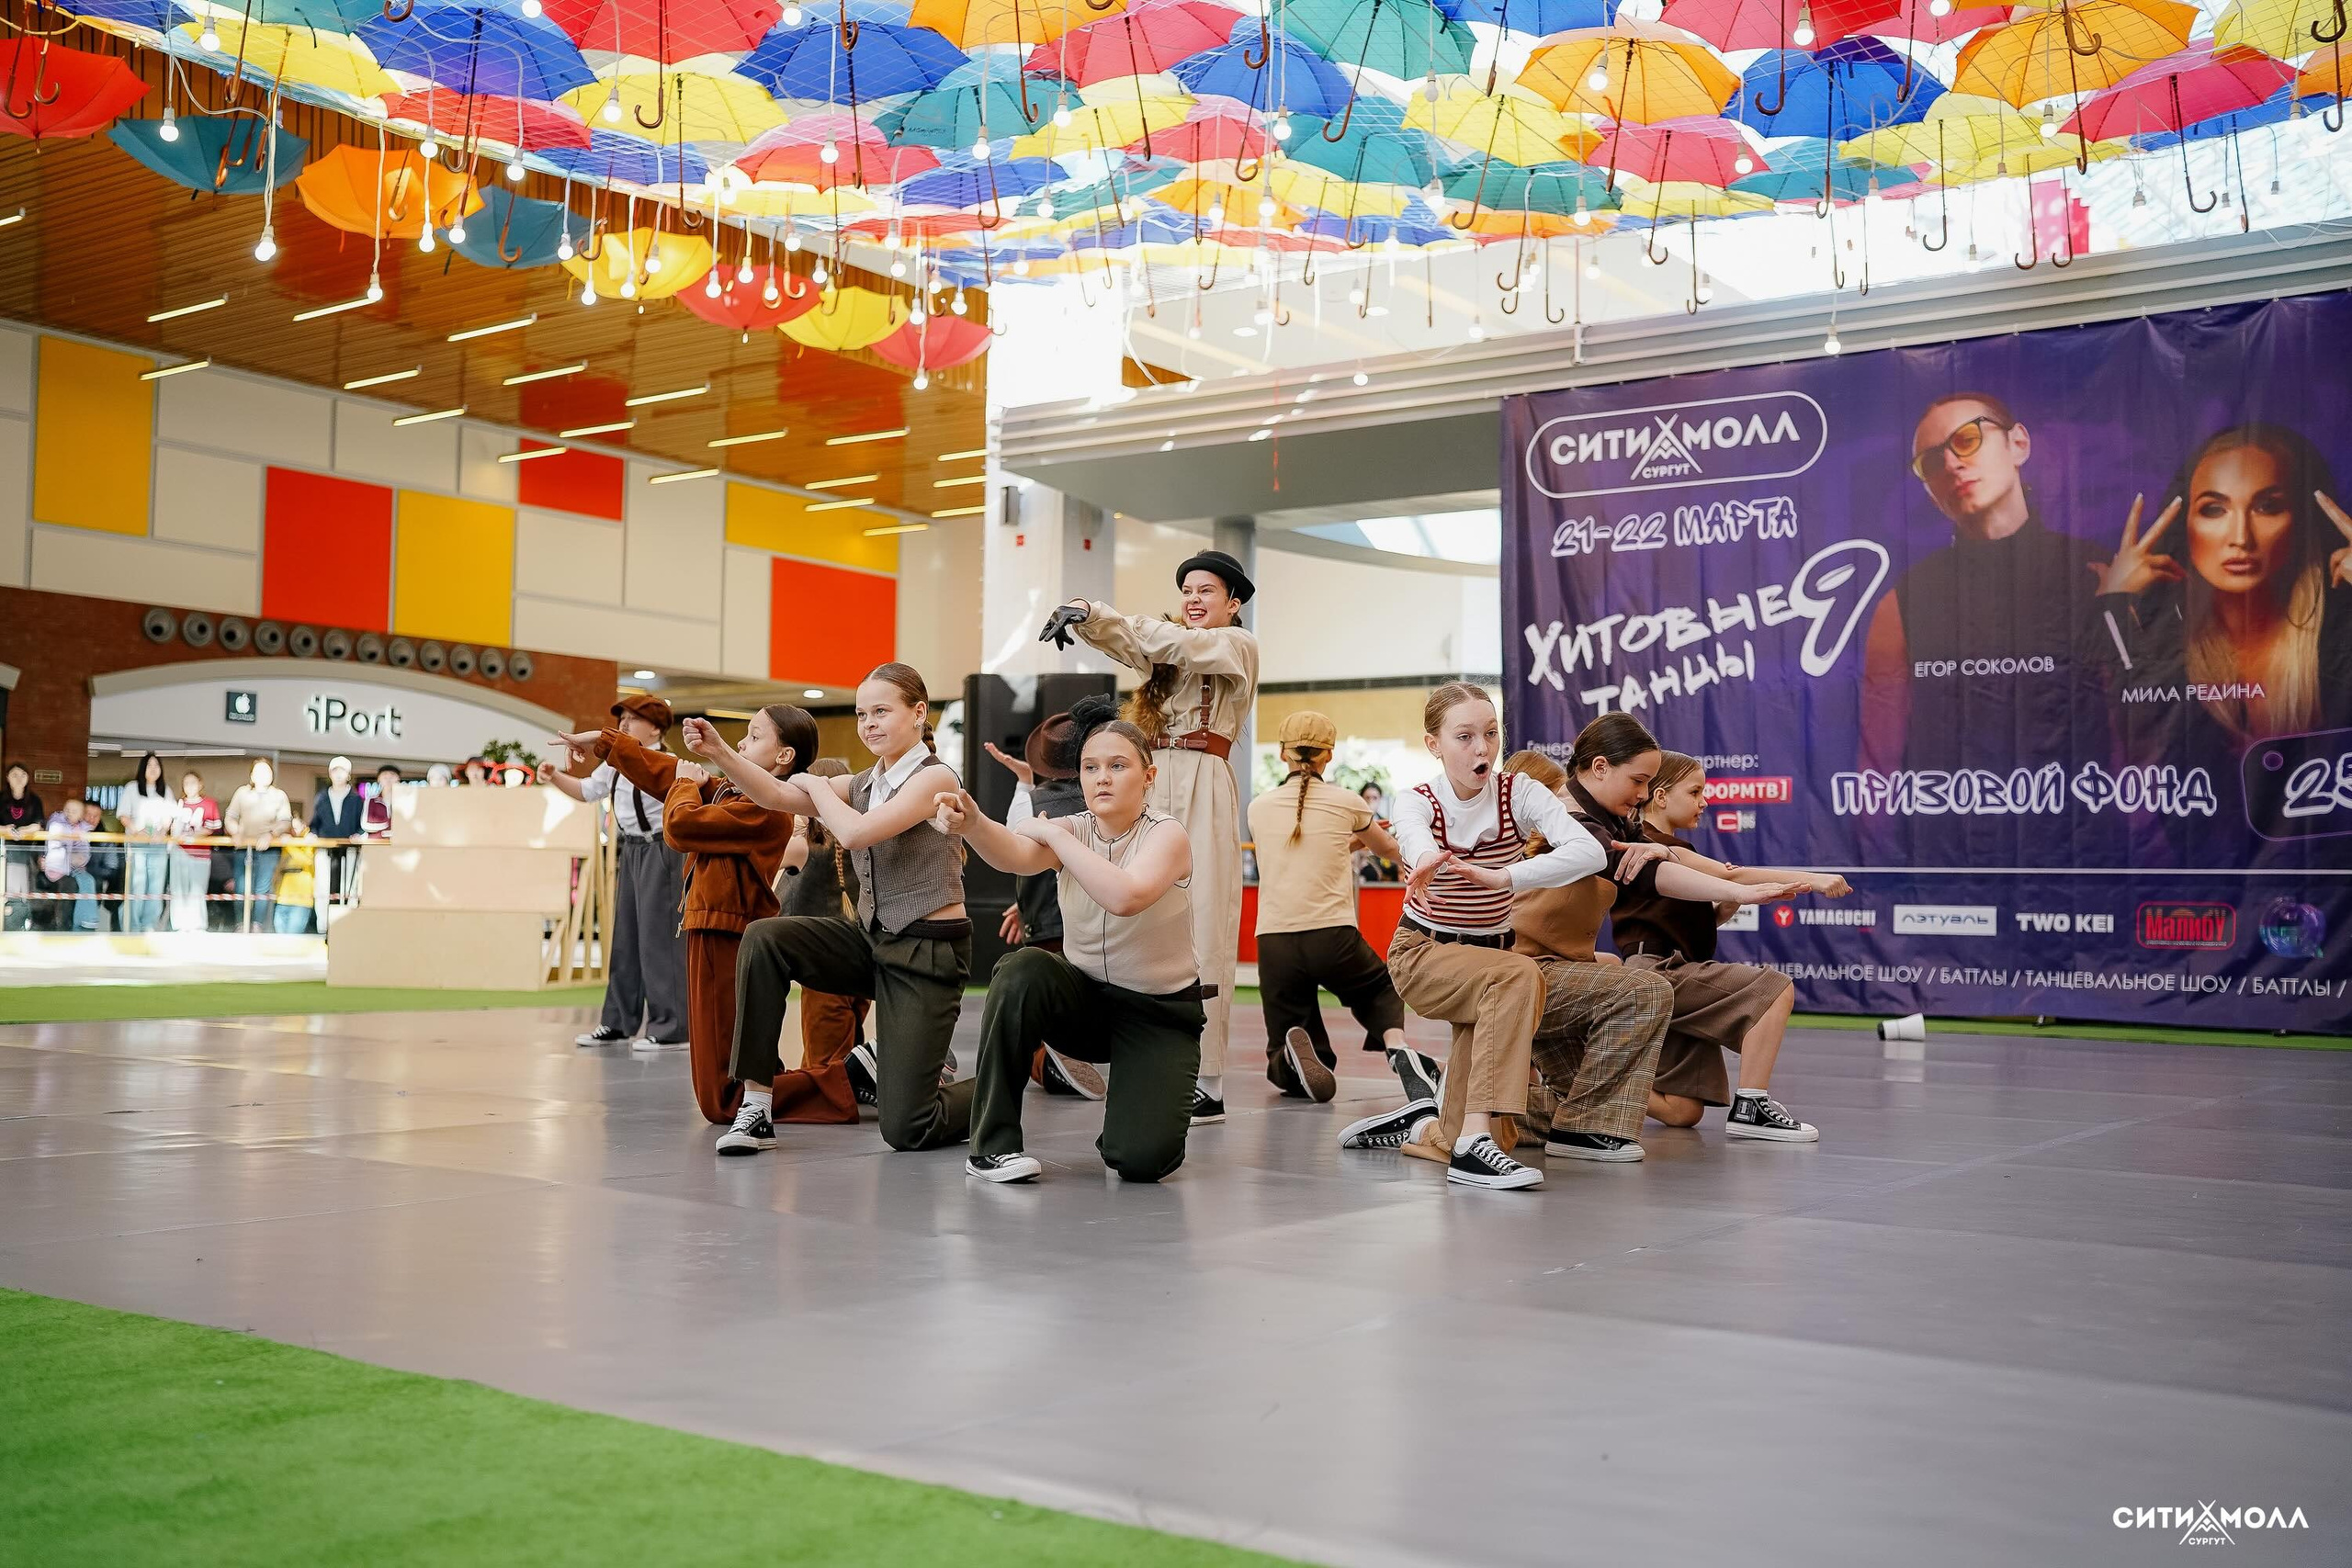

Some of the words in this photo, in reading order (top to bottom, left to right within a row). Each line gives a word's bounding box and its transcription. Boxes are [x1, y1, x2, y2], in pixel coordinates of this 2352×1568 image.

[1550, 425, 1651, 466] СИТИ
[1682, 410, 1801, 451] МОЛЛ
[1641, 462, 1691, 479] СУРГУТ
[1550, 511, 1668, 558] 21-22
[1673, 495, 1798, 547] МАРТА
[1523, 583, 1793, 692] ХИТОВЫЕ
[1579, 638, 1756, 716] ТАНЦЫ
[1914, 659, 1958, 678] ЕГОР
[1960, 655, 2055, 677] СОКОЛОВ
[2121, 684, 2181, 705] МИЛА
[2185, 682, 2267, 703] РЕДИНА
[303, 694, 401, 739] iPort
[1830, 761, 2065, 816] ПРИЗОВОЙ
[2070, 760, 2218, 818] ФОНД
[1797, 908, 1877, 927] YAMAGUCHI
[2015, 912, 2071, 932] TWO
[2075, 913, 2114, 933] KEI
[1877, 964, 1923, 983] ШОУ
[1939, 966, 2007, 987] БАТТЛЫ
[2024, 969, 2176, 992] ТАНЦЕВАЛЬНОЕ
[2180, 974, 2232, 994] ШОУ
[2253, 976, 2331, 997] БАТТЛЫ
